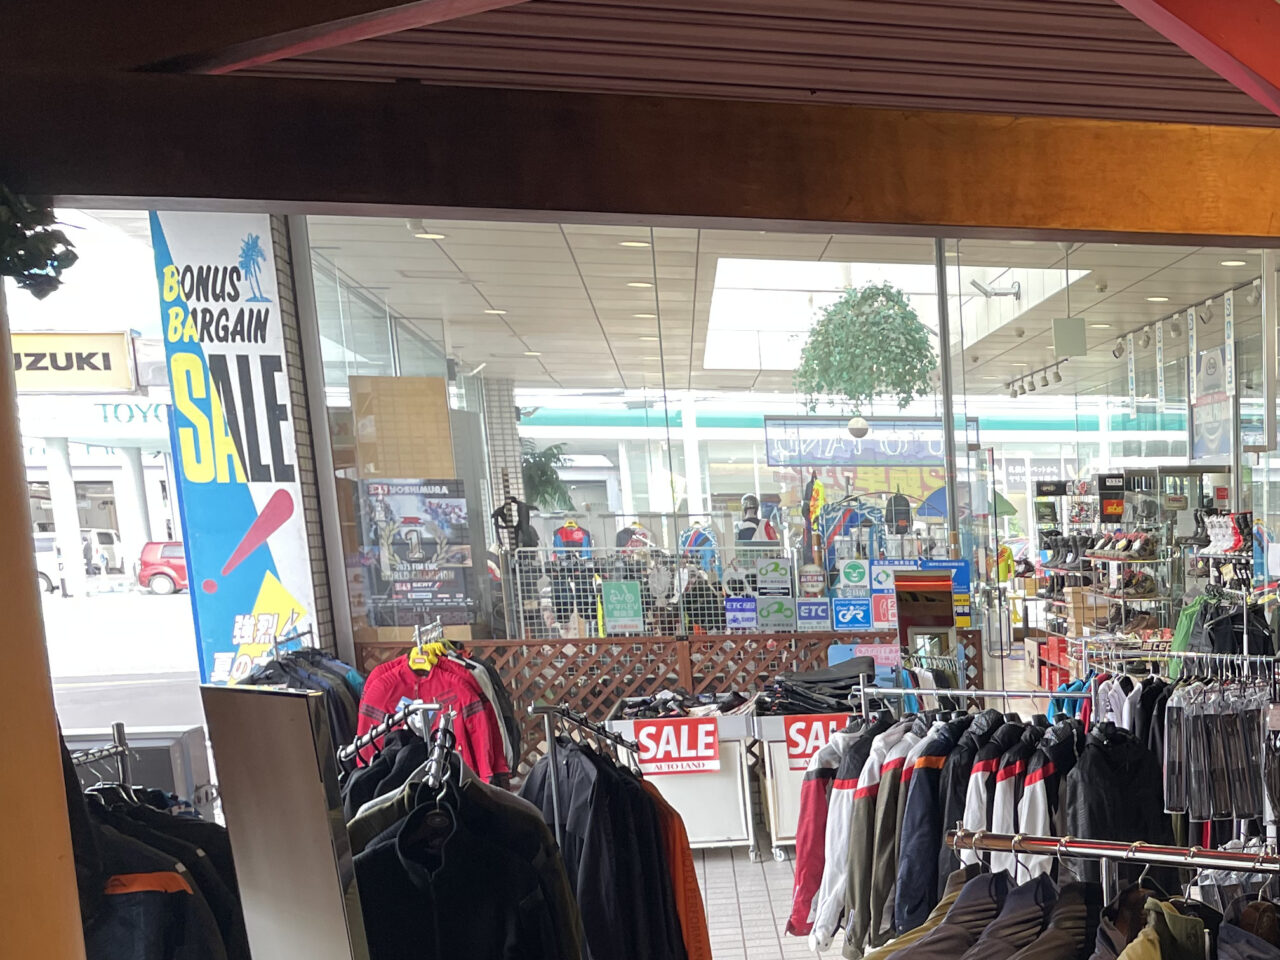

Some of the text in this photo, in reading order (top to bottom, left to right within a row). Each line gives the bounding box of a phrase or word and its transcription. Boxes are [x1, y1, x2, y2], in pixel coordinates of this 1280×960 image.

[163, 264, 241, 303] BONUS
[167, 306, 269, 344] BARGAIN
[171, 352, 296, 484] SALE
[801, 605, 827, 617] ETC
[638, 723, 715, 760] SALE
[788, 720, 836, 754] SA
